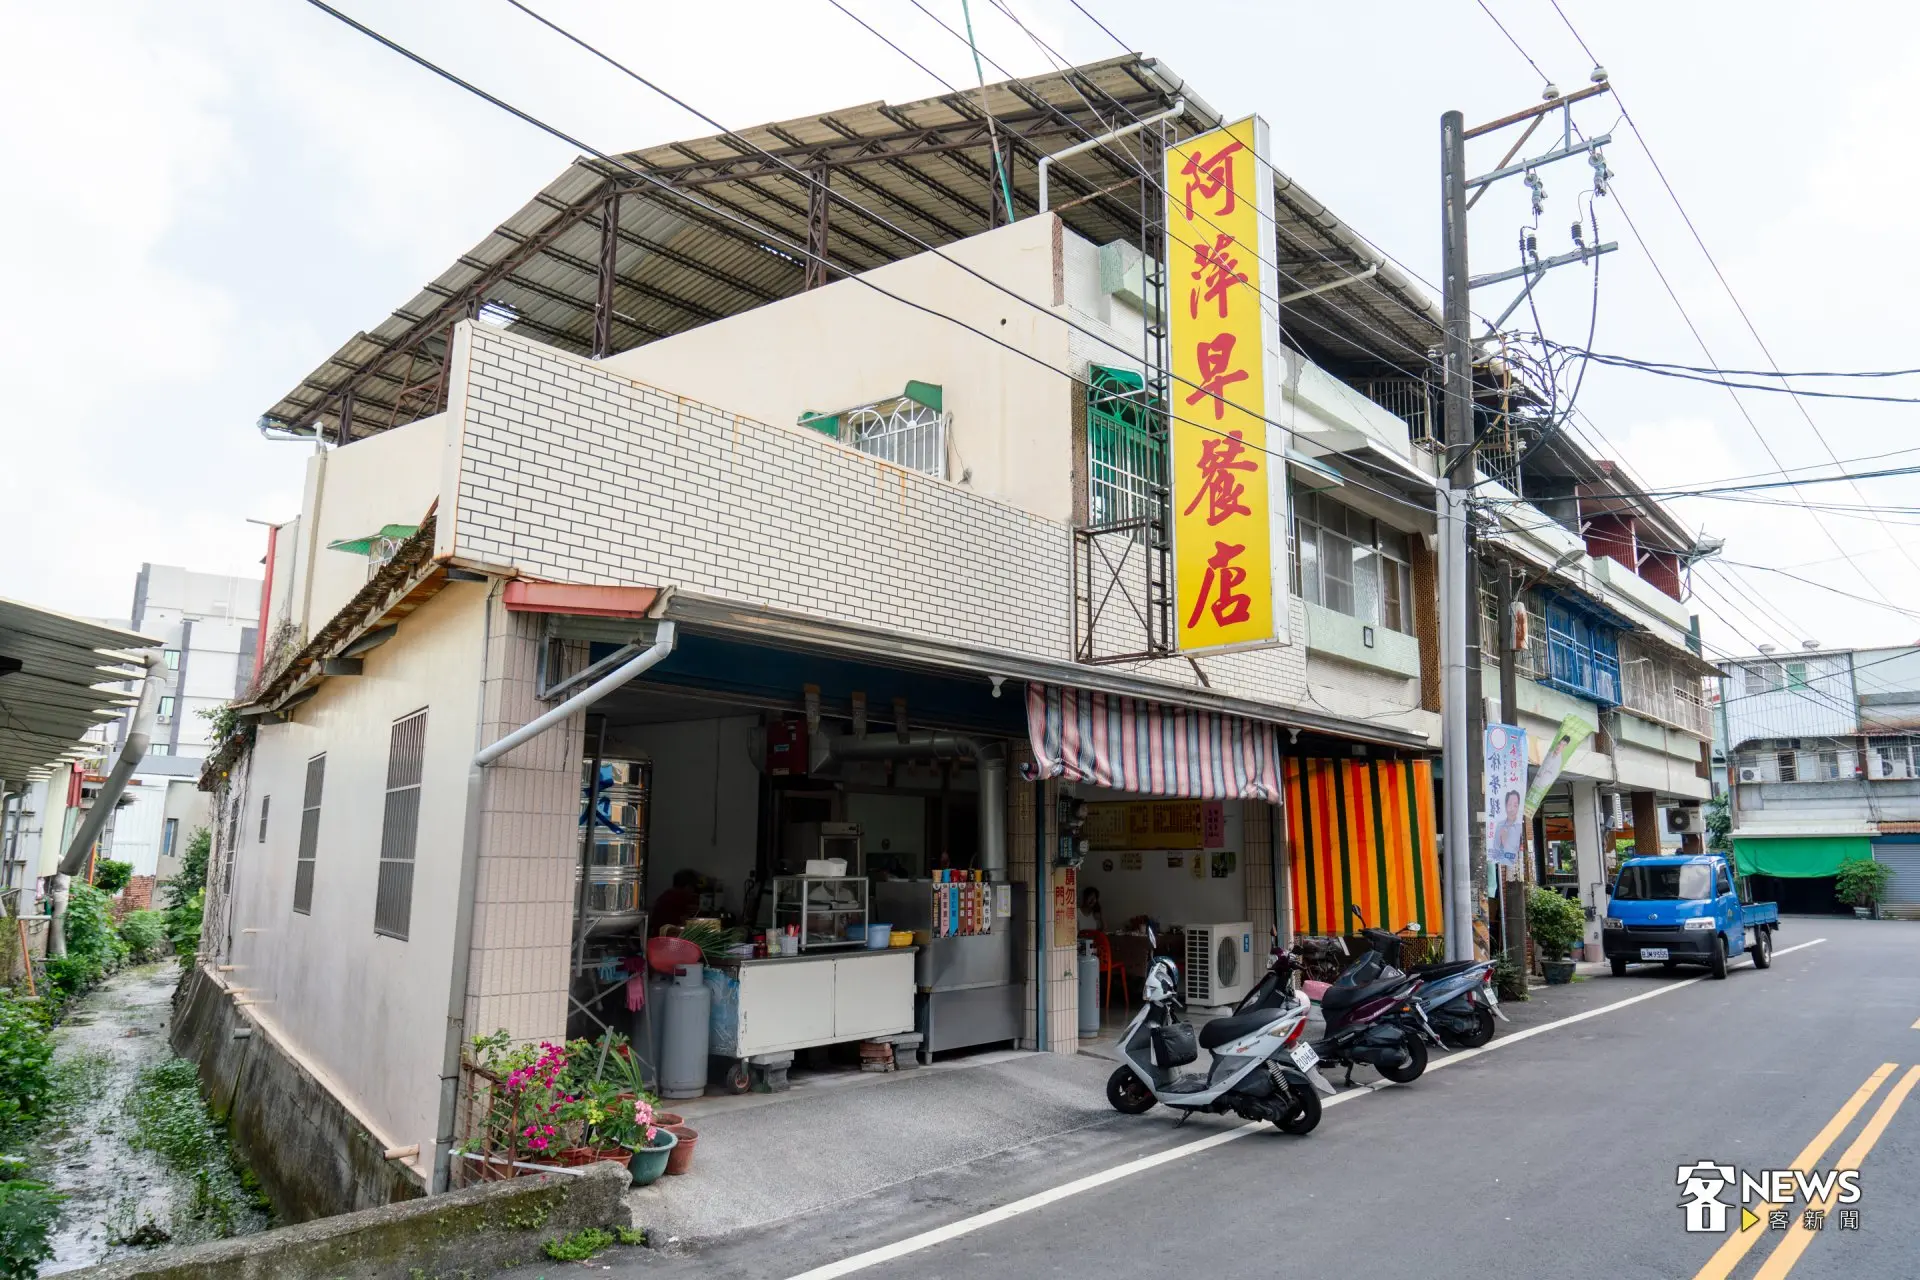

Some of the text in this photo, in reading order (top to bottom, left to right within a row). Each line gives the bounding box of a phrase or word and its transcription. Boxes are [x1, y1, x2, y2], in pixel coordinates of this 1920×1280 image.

[1183, 141, 1258, 629] 阿萍早餐店
